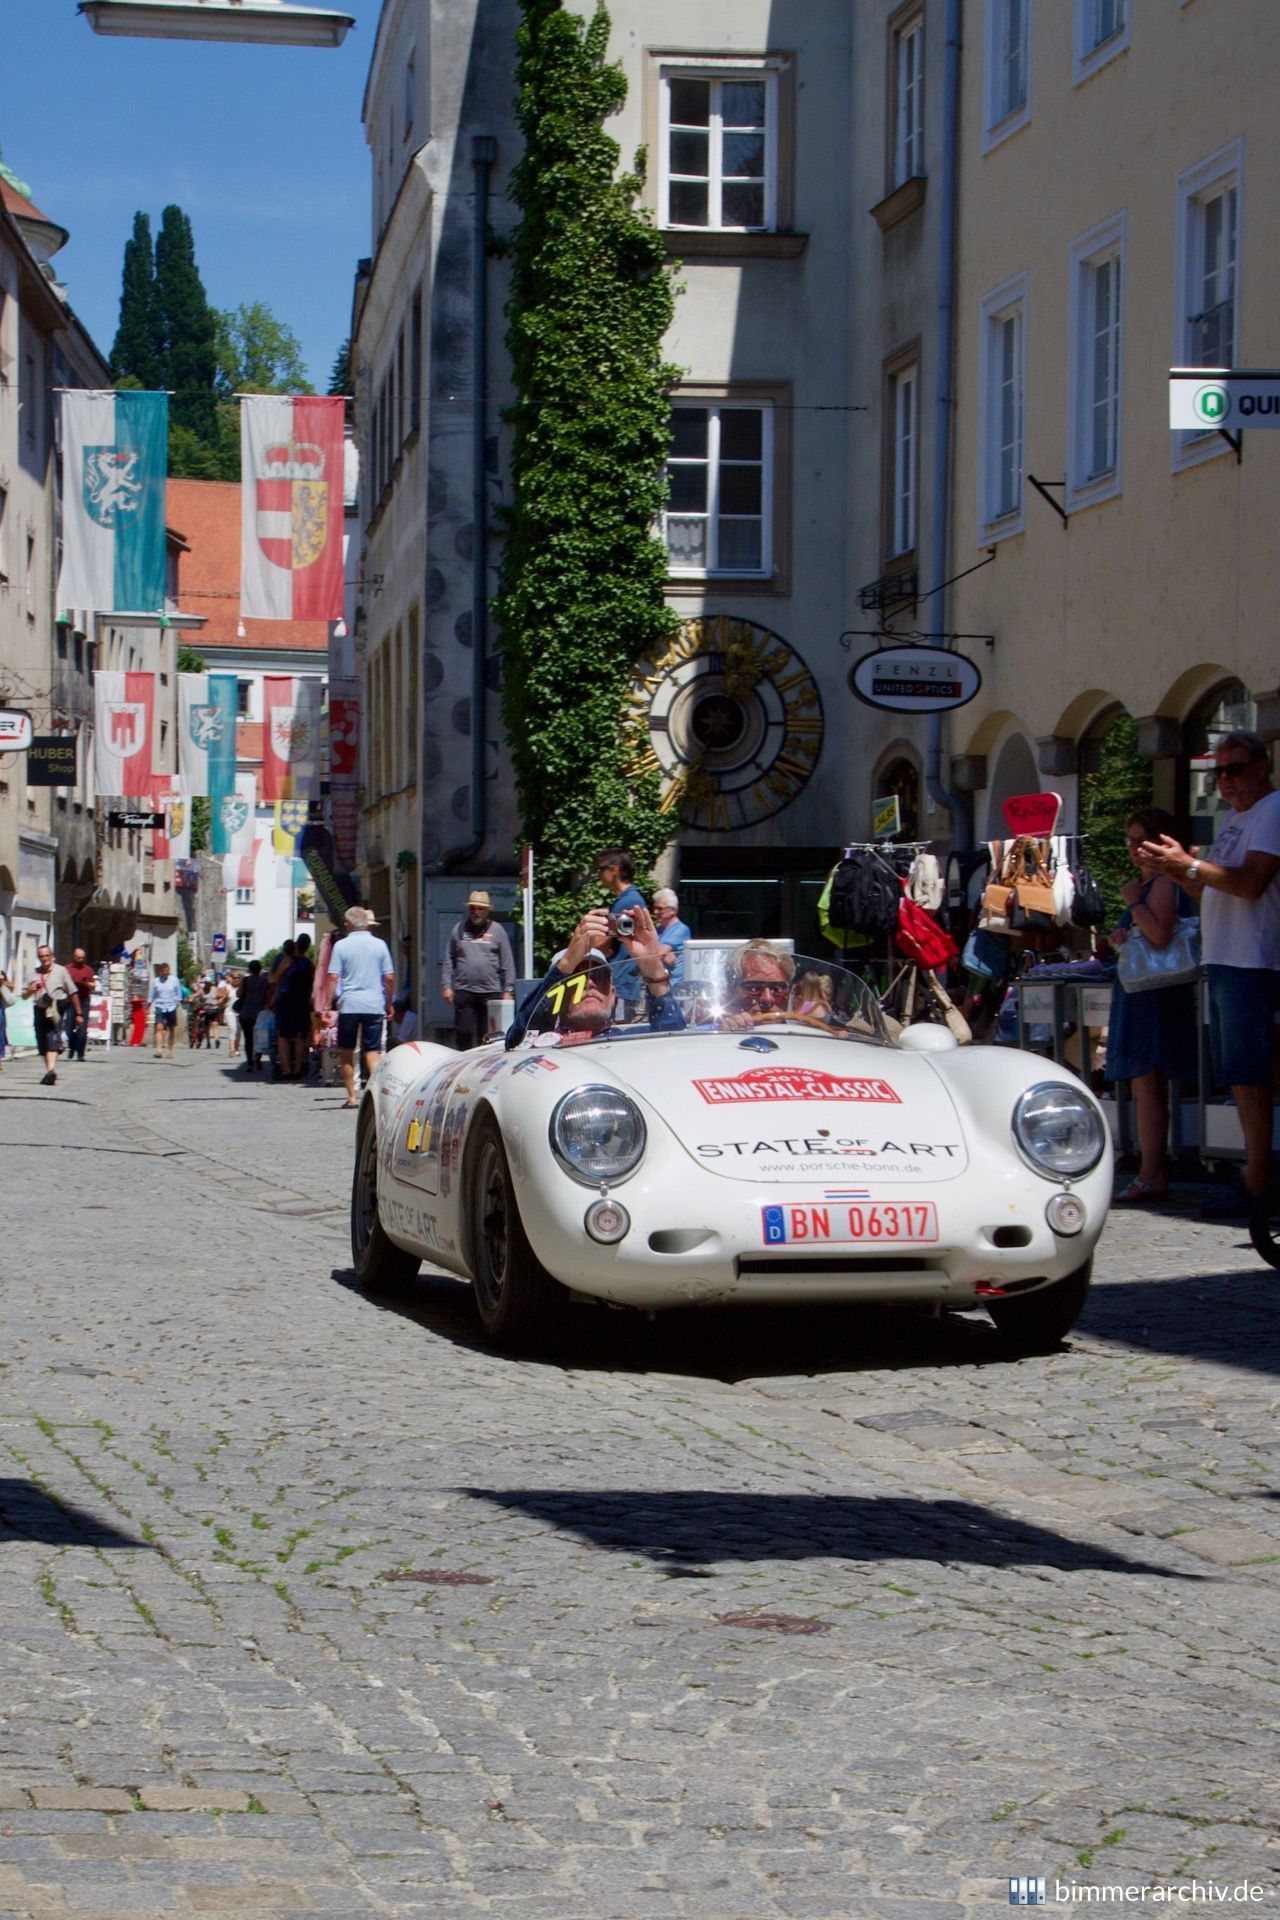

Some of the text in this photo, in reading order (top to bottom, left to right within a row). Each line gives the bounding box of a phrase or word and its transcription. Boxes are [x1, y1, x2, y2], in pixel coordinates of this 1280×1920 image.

[1238, 395, 1280, 416] QUI
[875, 665, 953, 677] FENZL
[28, 747, 74, 759] HUBER
[47, 763, 75, 774] Shop
[546, 973, 588, 1015] 77
[766, 1074, 815, 1082] 2018
[706, 1079, 893, 1100] ENNSTAL-CLASSIC
[696, 1138, 961, 1158] STATE OF ART
[758, 1160, 923, 1174] www.porsche-bonn.de
[769, 1206, 929, 1240] D BN 06317
